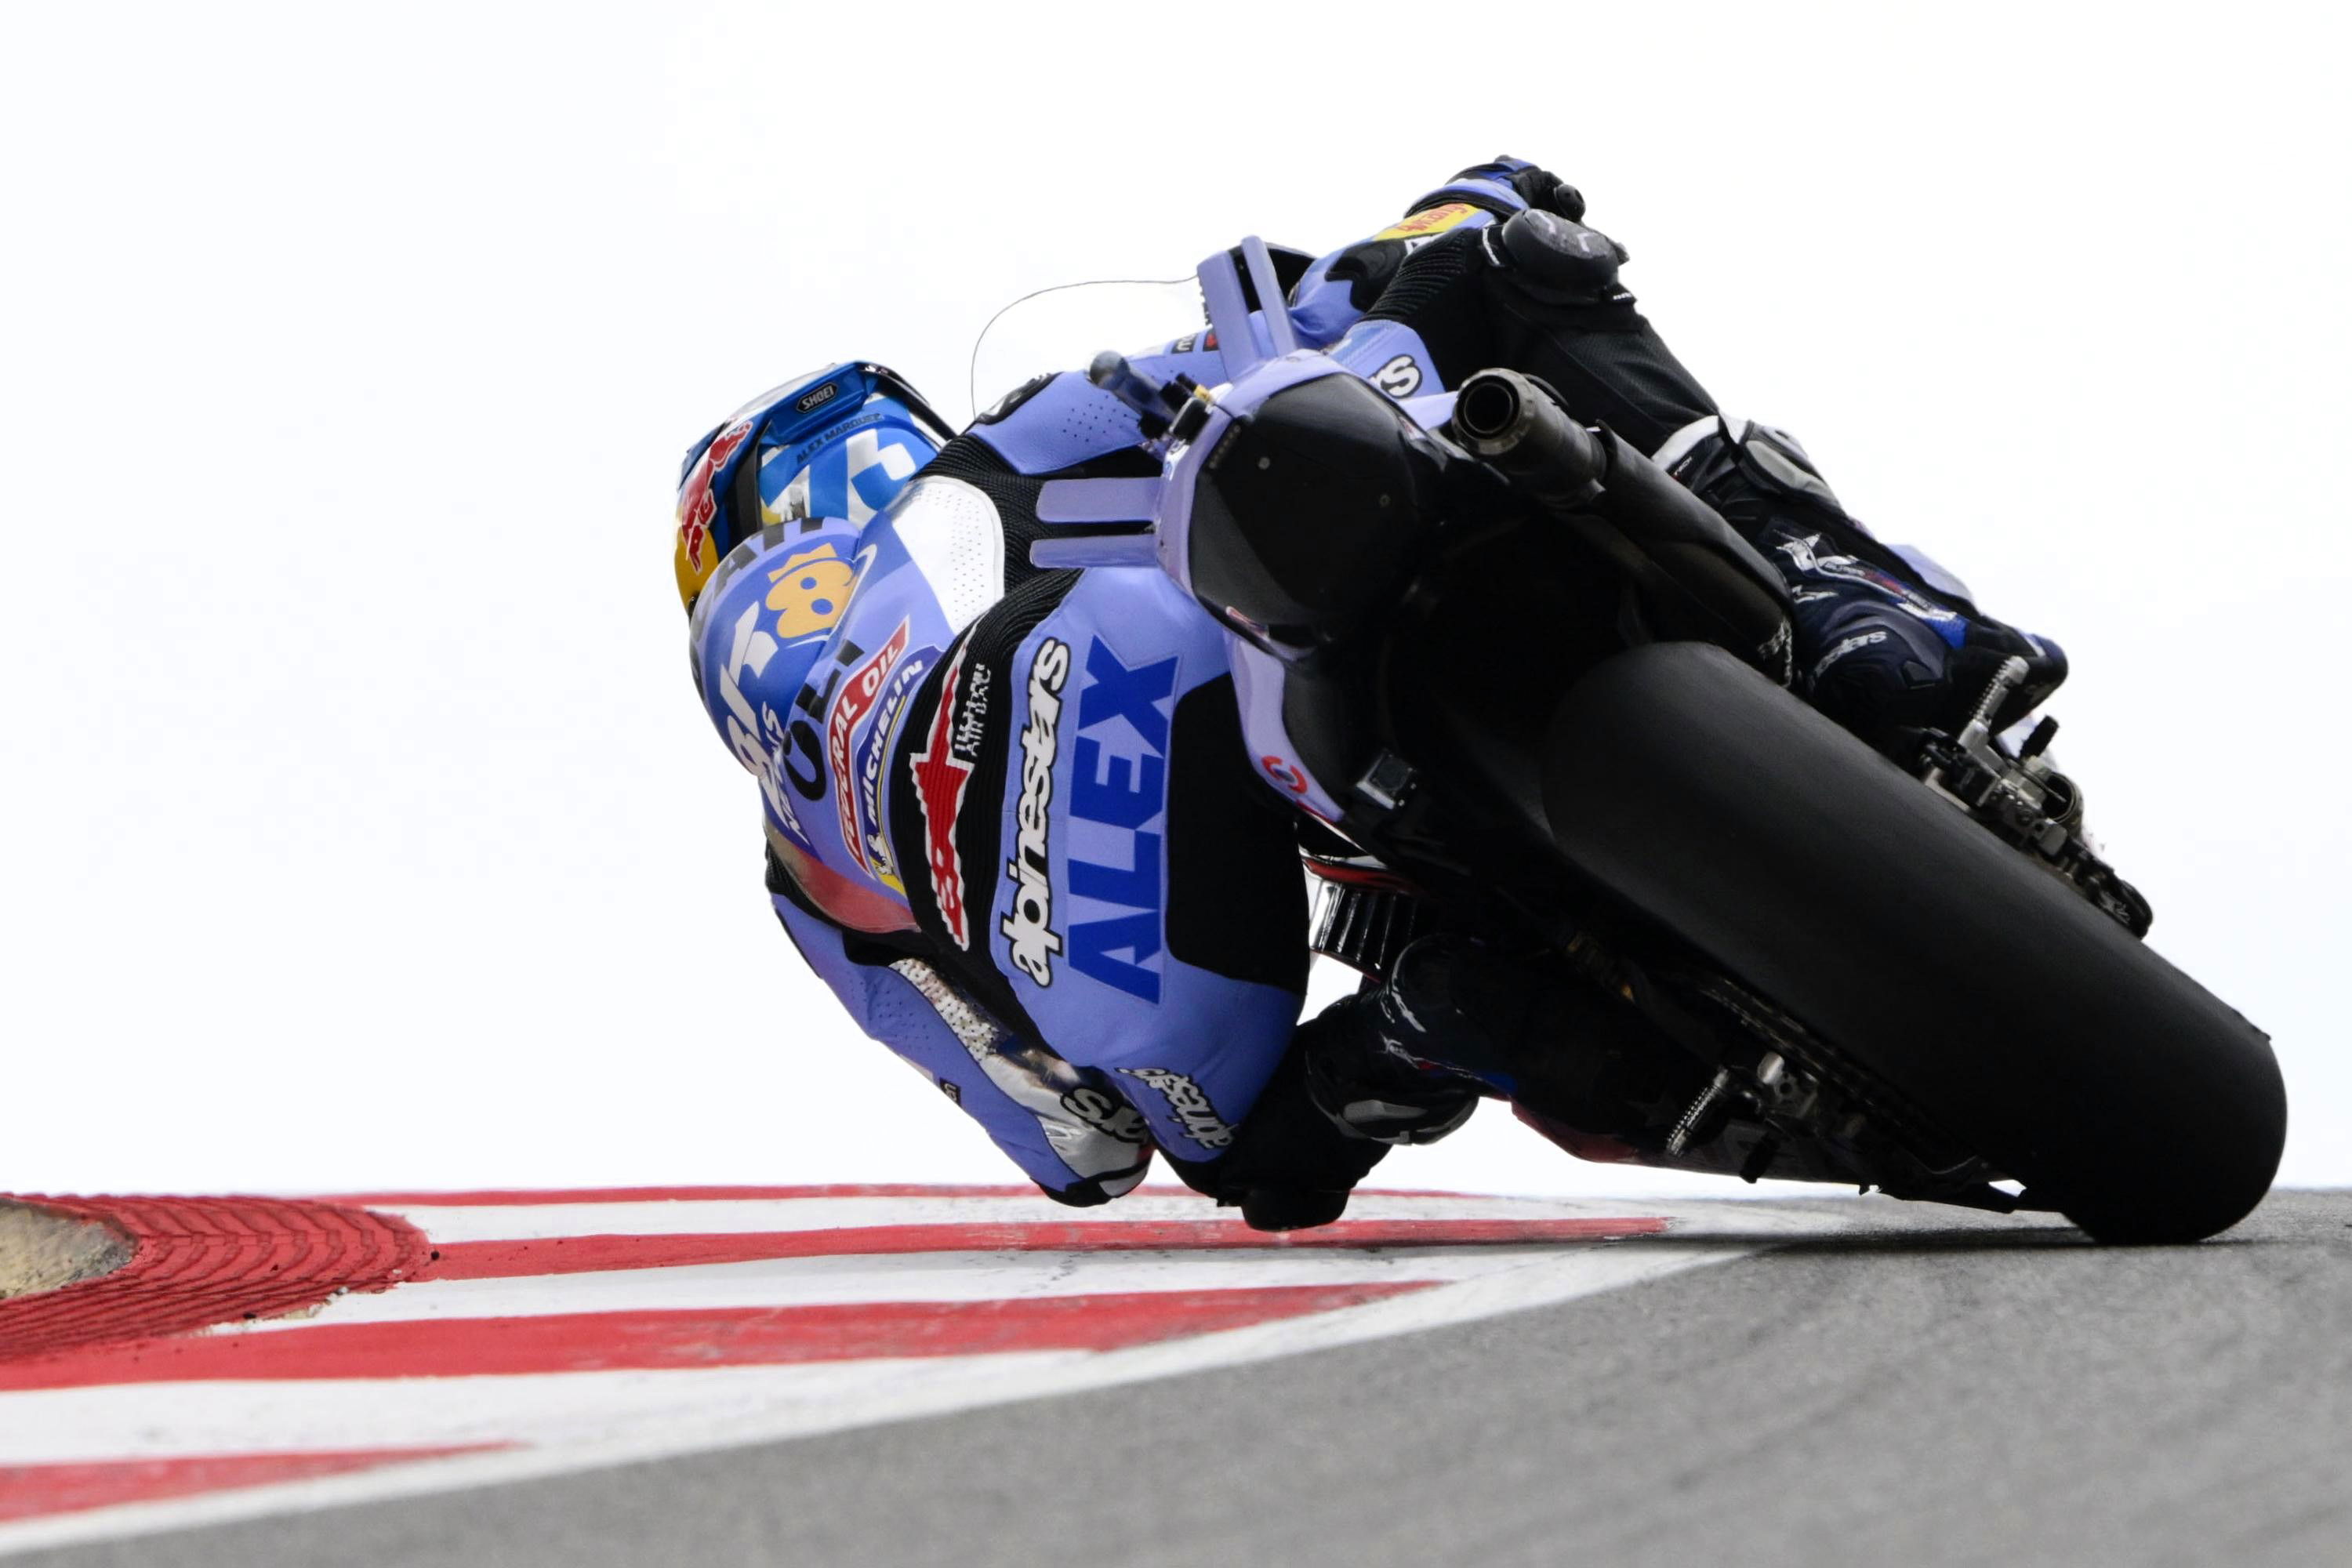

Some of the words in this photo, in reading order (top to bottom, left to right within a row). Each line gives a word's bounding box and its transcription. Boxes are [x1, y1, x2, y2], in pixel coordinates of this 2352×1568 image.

[796, 437, 823, 465] ALEX
[801, 384, 835, 410] SHOEI
[862, 643, 899, 698] OIL
[862, 659, 924, 828] MICHELIN
[1002, 639, 1069, 987] alpinestars
[1068, 633, 1178, 1005] ALEX
